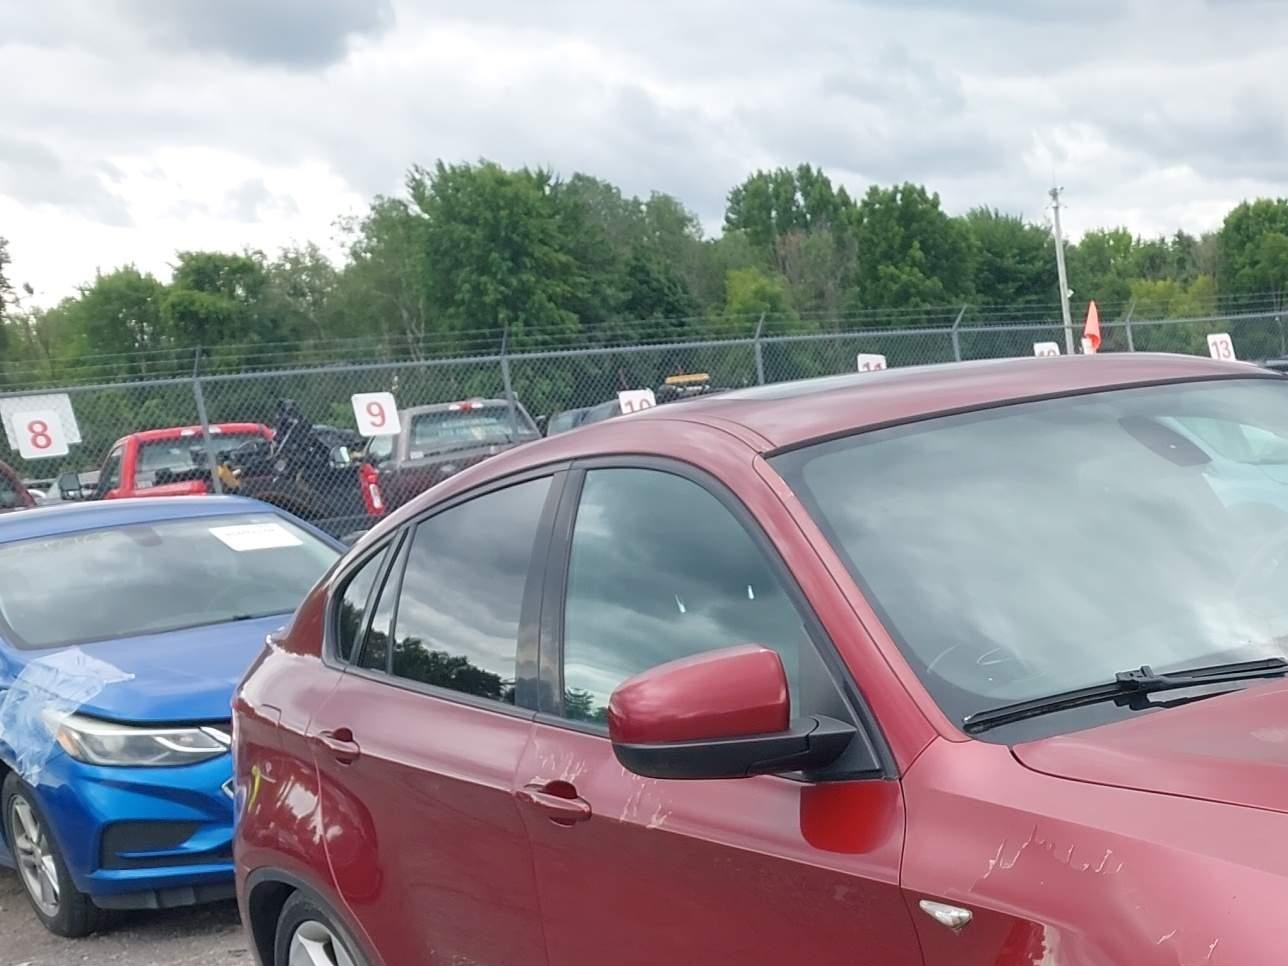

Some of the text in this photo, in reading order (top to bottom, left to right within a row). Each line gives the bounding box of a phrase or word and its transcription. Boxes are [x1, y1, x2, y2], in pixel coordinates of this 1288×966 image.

[1211, 340, 1231, 361] 13
[366, 401, 386, 428] 9
[27, 419, 52, 450] 8
